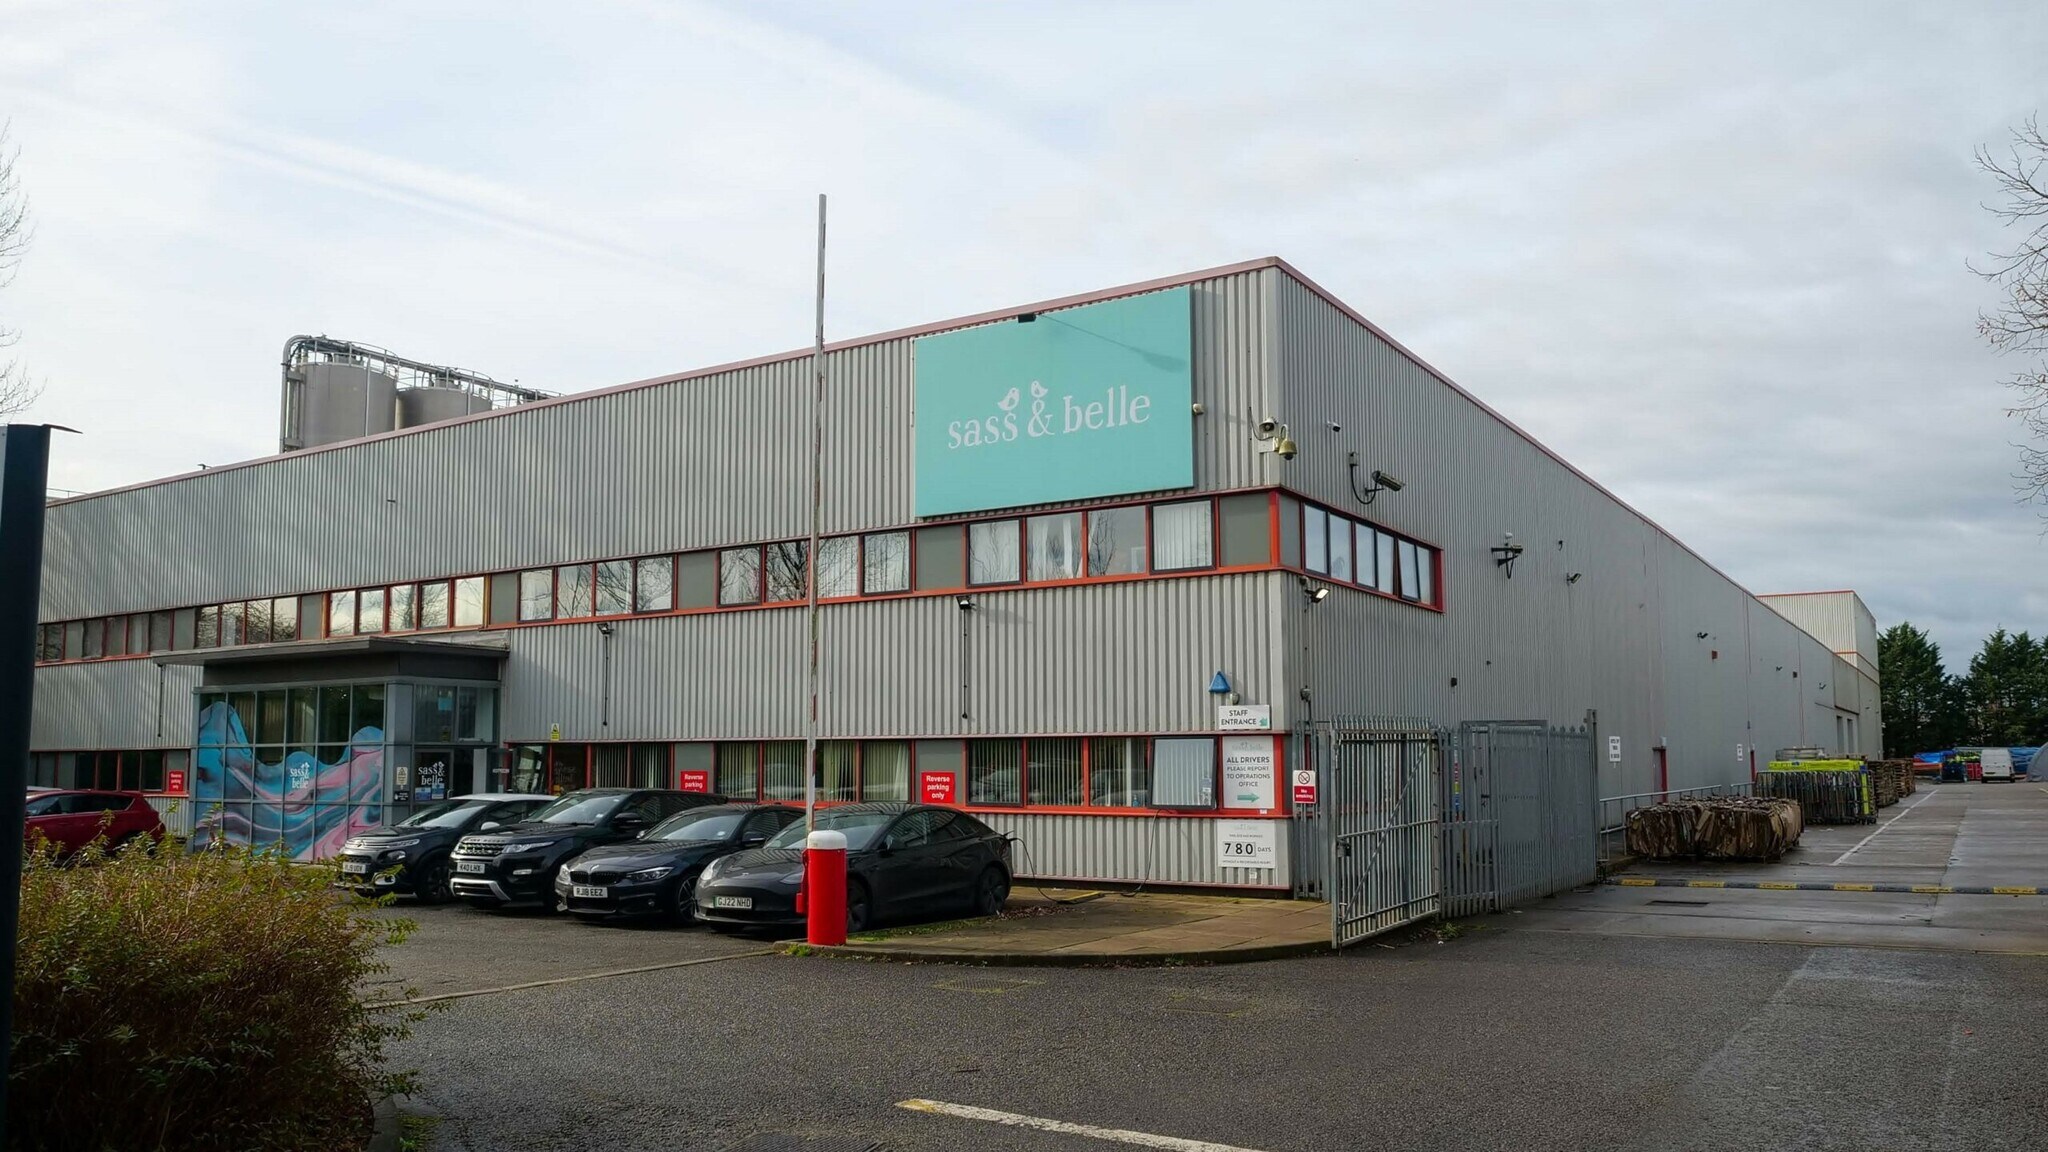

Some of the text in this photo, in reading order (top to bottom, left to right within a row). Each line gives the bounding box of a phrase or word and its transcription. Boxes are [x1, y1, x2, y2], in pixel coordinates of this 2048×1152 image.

[948, 385, 1150, 449] sass & belle
[1229, 709, 1248, 717] STAFF
[1221, 718, 1257, 726] ENTRANCE
[1226, 756, 1270, 764] ALL DRIVERS
[418, 765, 438, 775] sass
[421, 775, 444, 786] belle
[926, 783, 950, 792] parking
[931, 791, 945, 800] only
